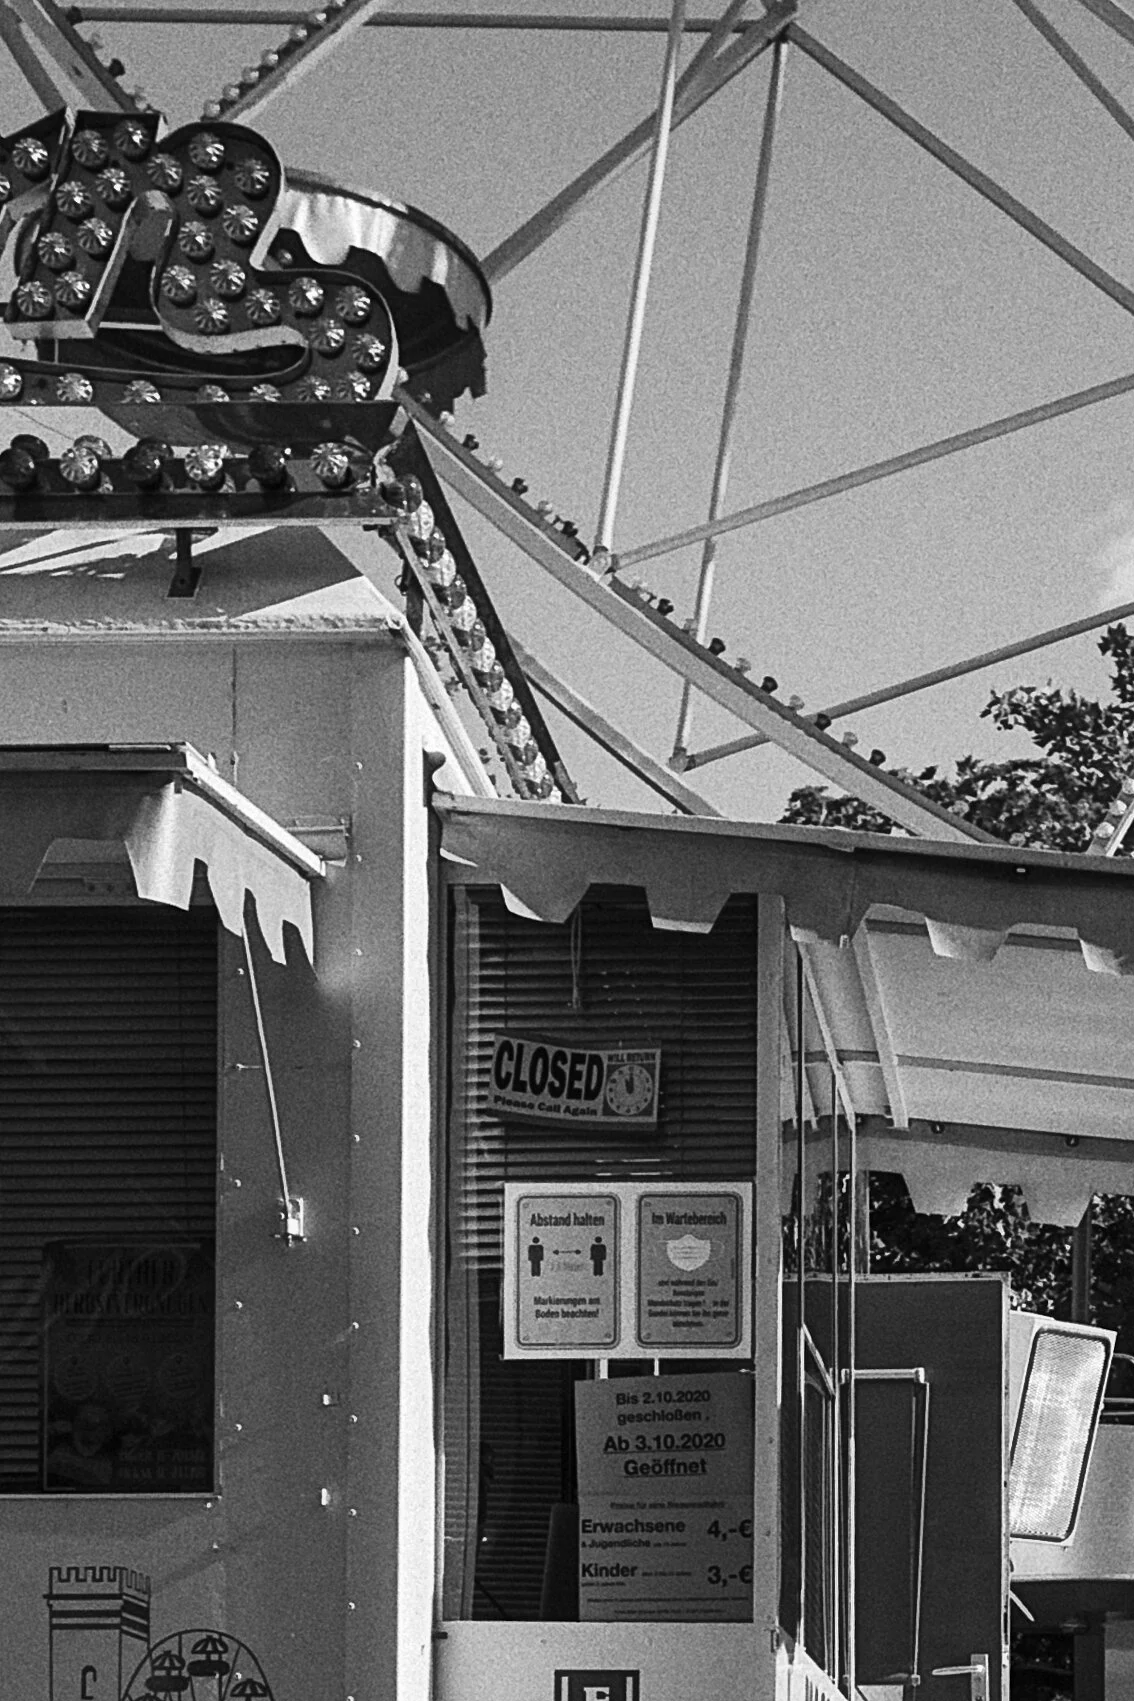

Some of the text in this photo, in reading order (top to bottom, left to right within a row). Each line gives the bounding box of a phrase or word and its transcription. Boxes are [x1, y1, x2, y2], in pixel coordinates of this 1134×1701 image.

[494, 1040, 604, 1101] CLOSED
[493, 1094, 598, 1117] Please Call Again
[529, 1212, 606, 1227] Abstand halten
[665, 1211, 727, 1226] Wartebereich
[533, 1295, 587, 1307] Markierungen
[615, 1389, 711, 1405] Bis 2.10.2020
[617, 1406, 702, 1426] geschloßen
[603, 1431, 726, 1452] Ab 3.10.2020
[623, 1457, 708, 1477] Geöffnet
[581, 1518, 753, 1542] Erwachsene 4,-€
[588, 1539, 651, 1550] Jugendliche
[581, 1562, 638, 1578] Kinder
[706, 1565, 753, 1588] 3,-€
